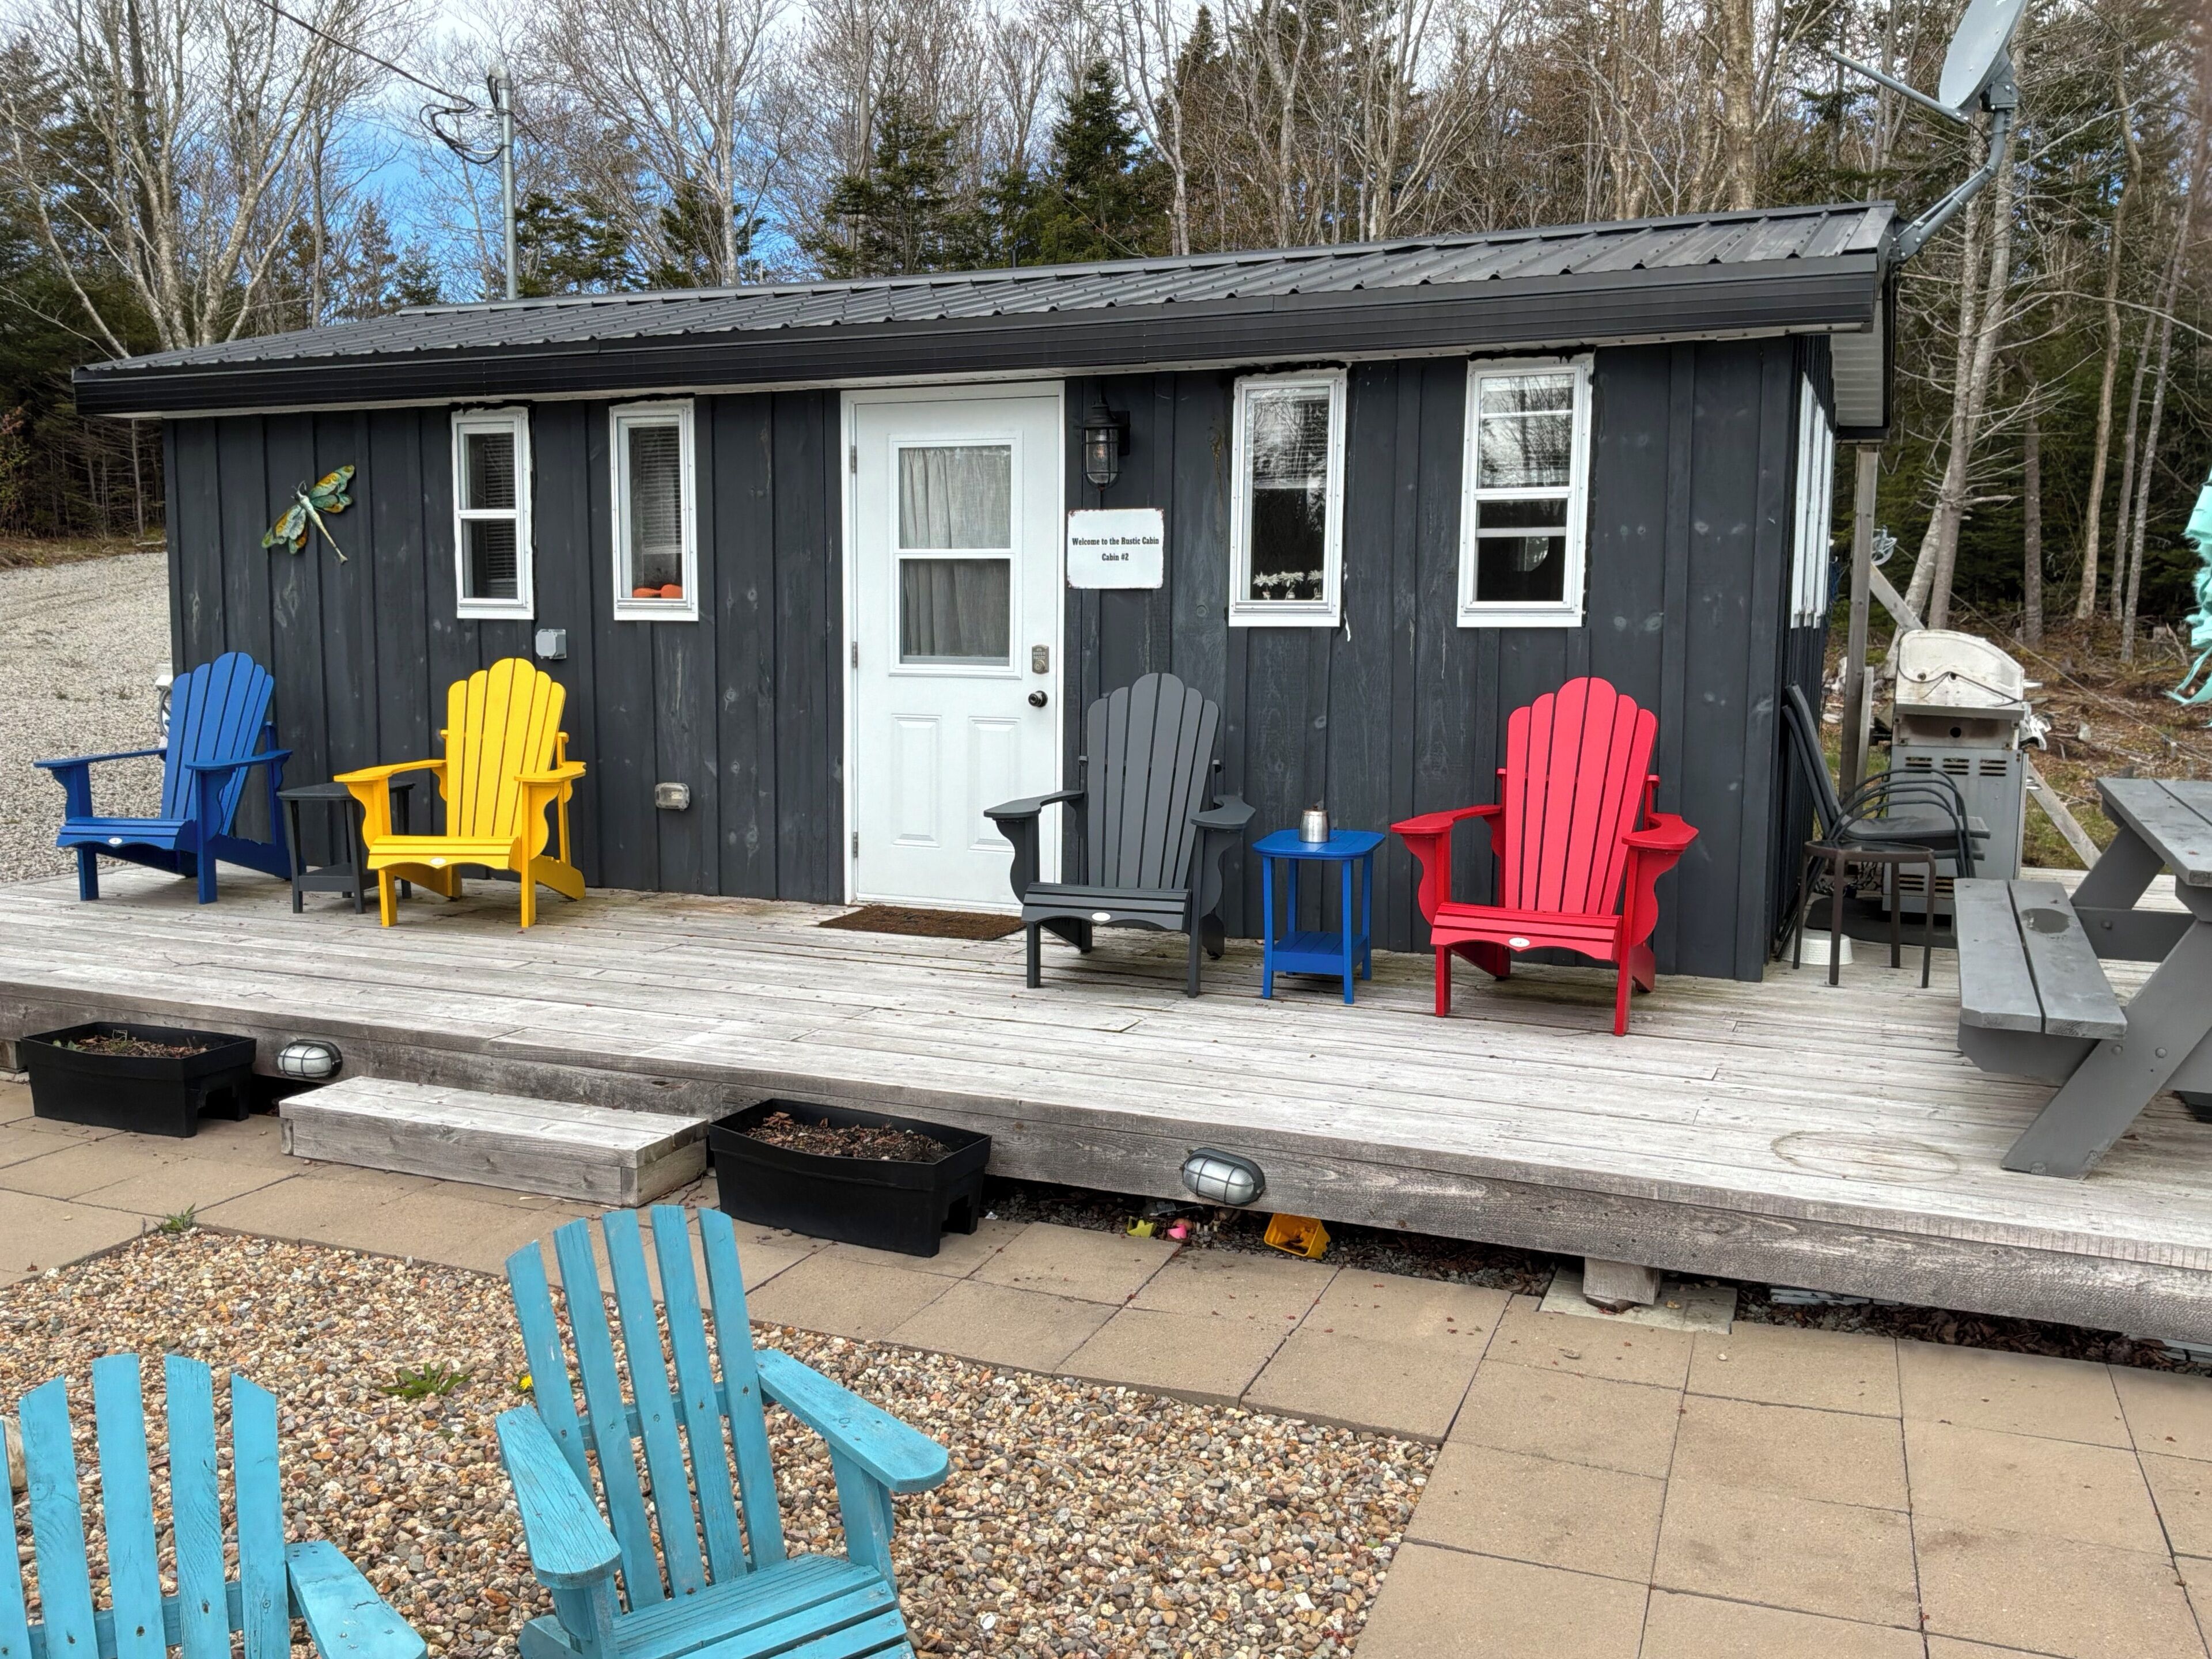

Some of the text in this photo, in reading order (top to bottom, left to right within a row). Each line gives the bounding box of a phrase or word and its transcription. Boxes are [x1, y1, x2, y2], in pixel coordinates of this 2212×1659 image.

[1071, 537, 1100, 546] Welcome
[1109, 537, 1119, 545] the
[1121, 537, 1141, 545] Rustic
[1142, 536, 1159, 544] Cabin
[1101, 553, 1129, 561] Cabin #2
